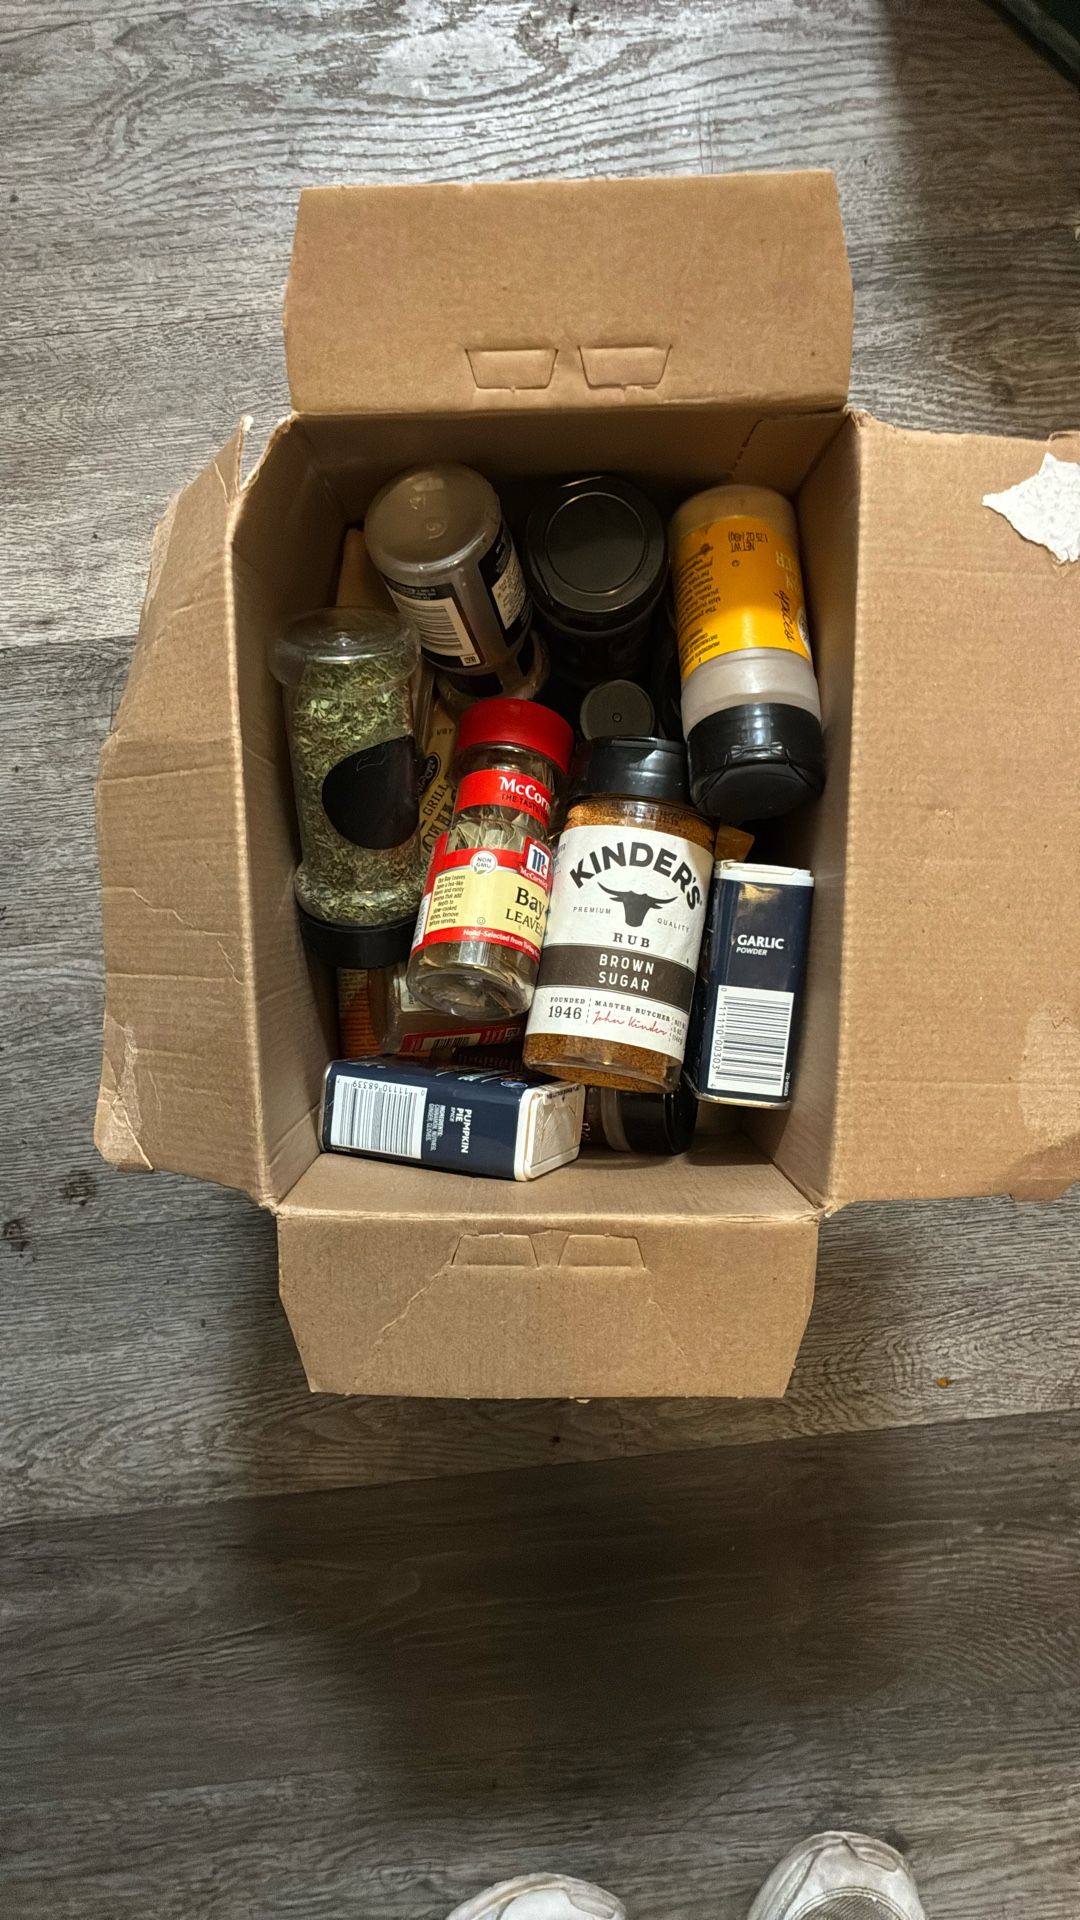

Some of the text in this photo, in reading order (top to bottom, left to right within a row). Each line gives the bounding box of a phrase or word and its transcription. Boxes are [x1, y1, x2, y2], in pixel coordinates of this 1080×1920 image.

[731, 541, 755, 552] NET WT
[422, 783, 449, 818] GRILL
[498, 776, 551, 816] McCorm
[569, 841, 701, 910] KINDER'S
[515, 886, 546, 920] Bay
[572, 906, 612, 915] PREMIUM
[505, 908, 544, 938] LEAVES
[657, 917, 690, 932] QUALITY
[612, 932, 651, 949] RUB
[737, 934, 785, 950] GARLIC
[736, 947, 768, 957] POWDER
[599, 953, 655, 976] BROWN
[598, 971, 650, 992] SUGAR
[550, 996, 586, 1005] FOUNDED
[548, 1006, 583, 1020] 1946
[592, 1010, 625, 1025] John
[594, 1000, 671, 1022] MASTER BUTCHER
[716, 1006, 727, 1035] 11110
[712, 1040, 723, 1070] 00303
[352, 1080, 379, 1090] 68339
[383, 1084, 408, 1095] 11110
[456, 1107, 464, 1122] PIE
[461, 1108, 472, 1154] PUMPKIN
